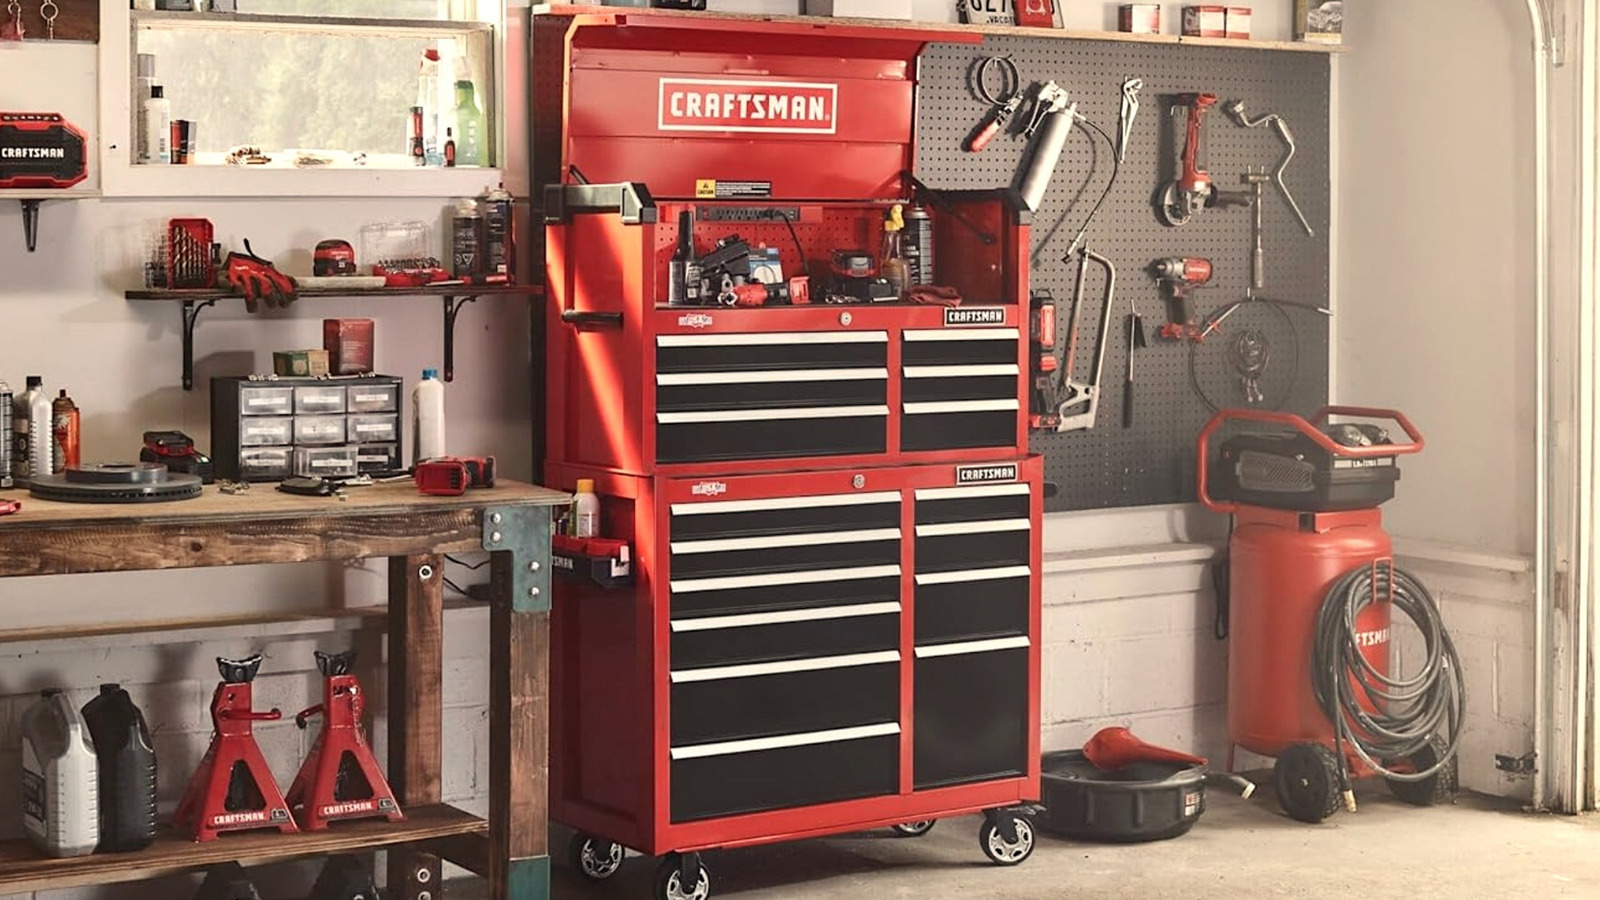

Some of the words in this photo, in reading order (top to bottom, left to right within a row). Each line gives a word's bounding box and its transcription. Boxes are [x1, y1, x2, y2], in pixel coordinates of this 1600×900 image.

[670, 91, 825, 121] CRAFTSMAN
[1, 147, 65, 159] CRAFTSMAN
[948, 311, 1003, 323] CRAFTSMAN
[960, 467, 1015, 481] CRAFTSMAN
[323, 800, 373, 816] CRAFTSMAN
[213, 811, 265, 825] CRAFTSMAN
